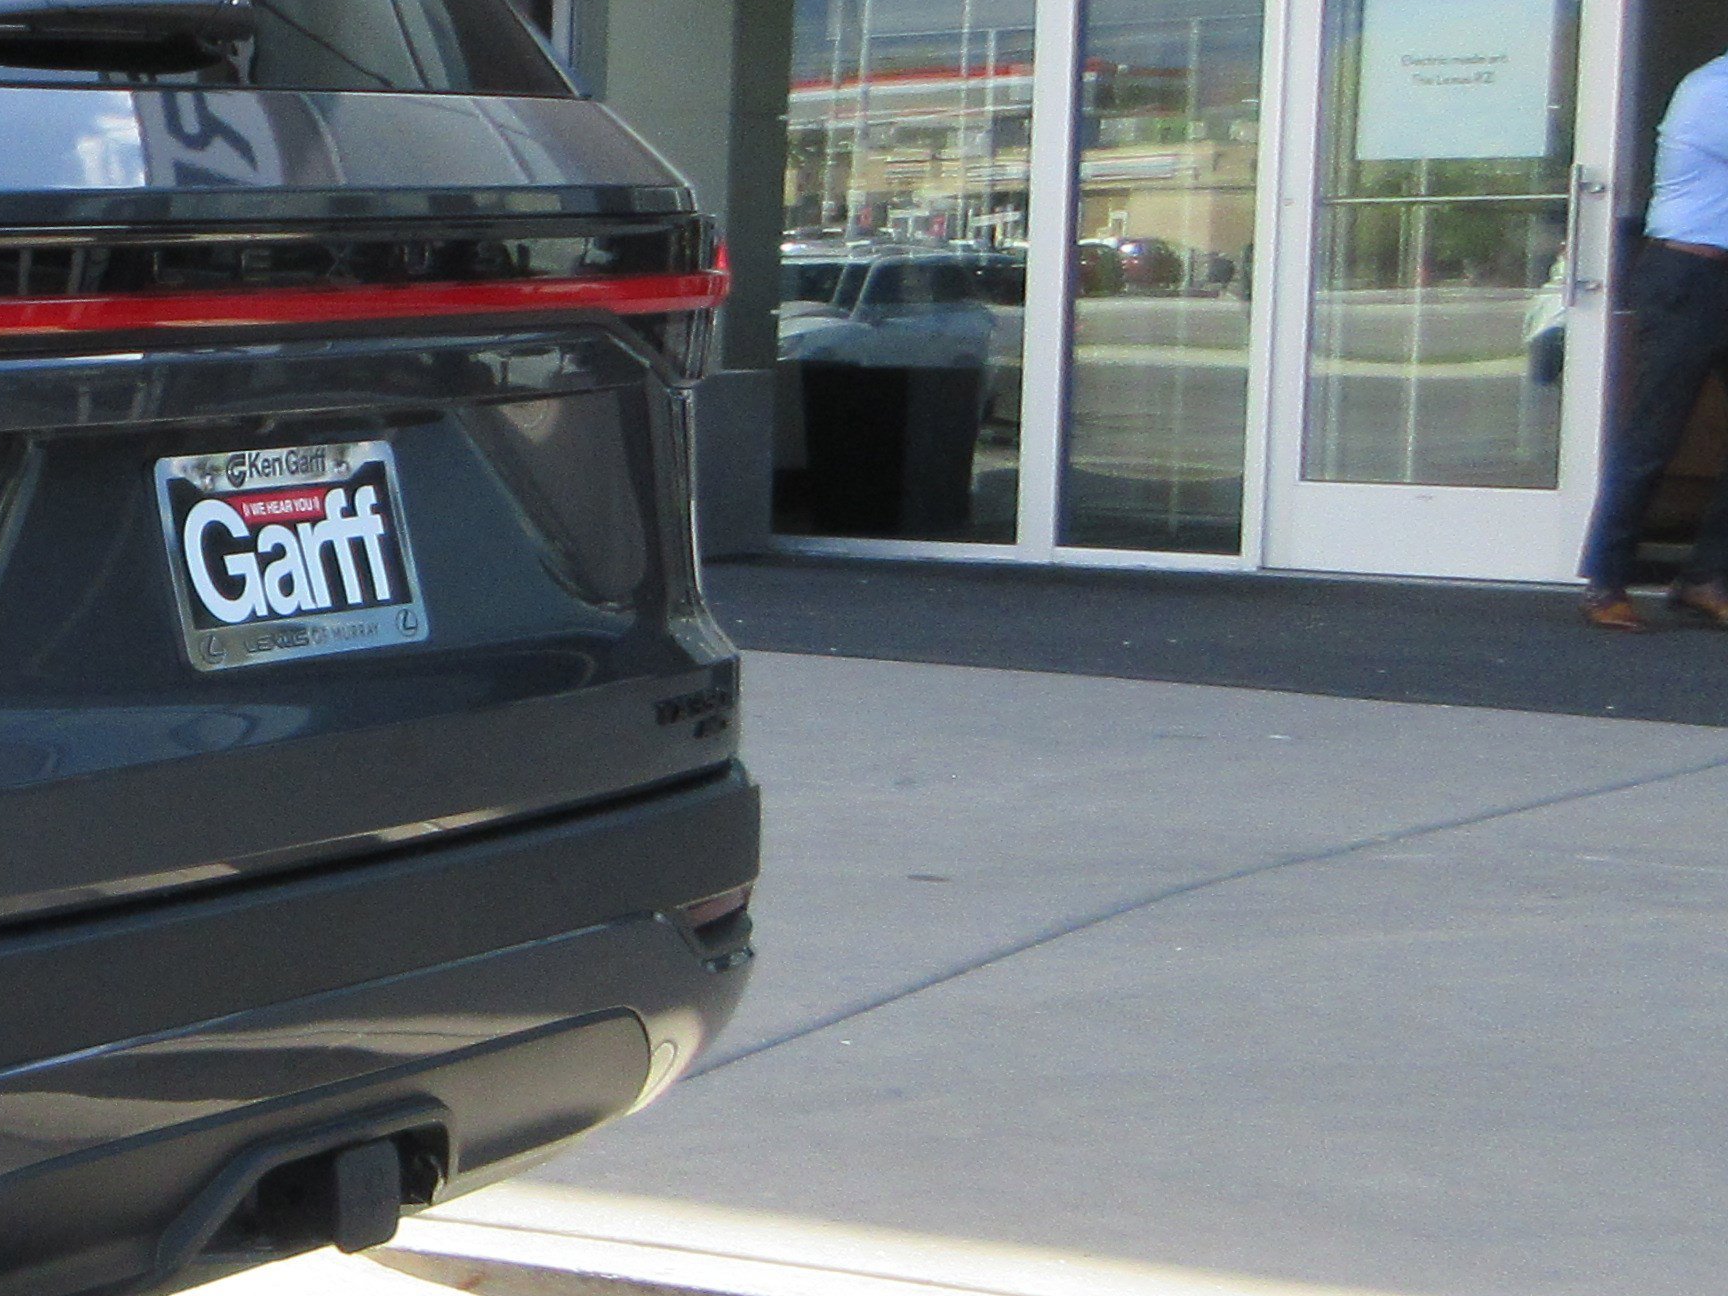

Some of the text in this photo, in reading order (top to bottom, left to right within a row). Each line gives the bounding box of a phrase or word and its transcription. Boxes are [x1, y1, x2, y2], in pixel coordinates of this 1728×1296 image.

[152, 240, 512, 287] LEXUS
[247, 447, 326, 478] Ken Garff
[250, 496, 313, 516] WE HEAR YOU
[183, 485, 391, 623] Garff
[244, 628, 310, 653] LEXUS
